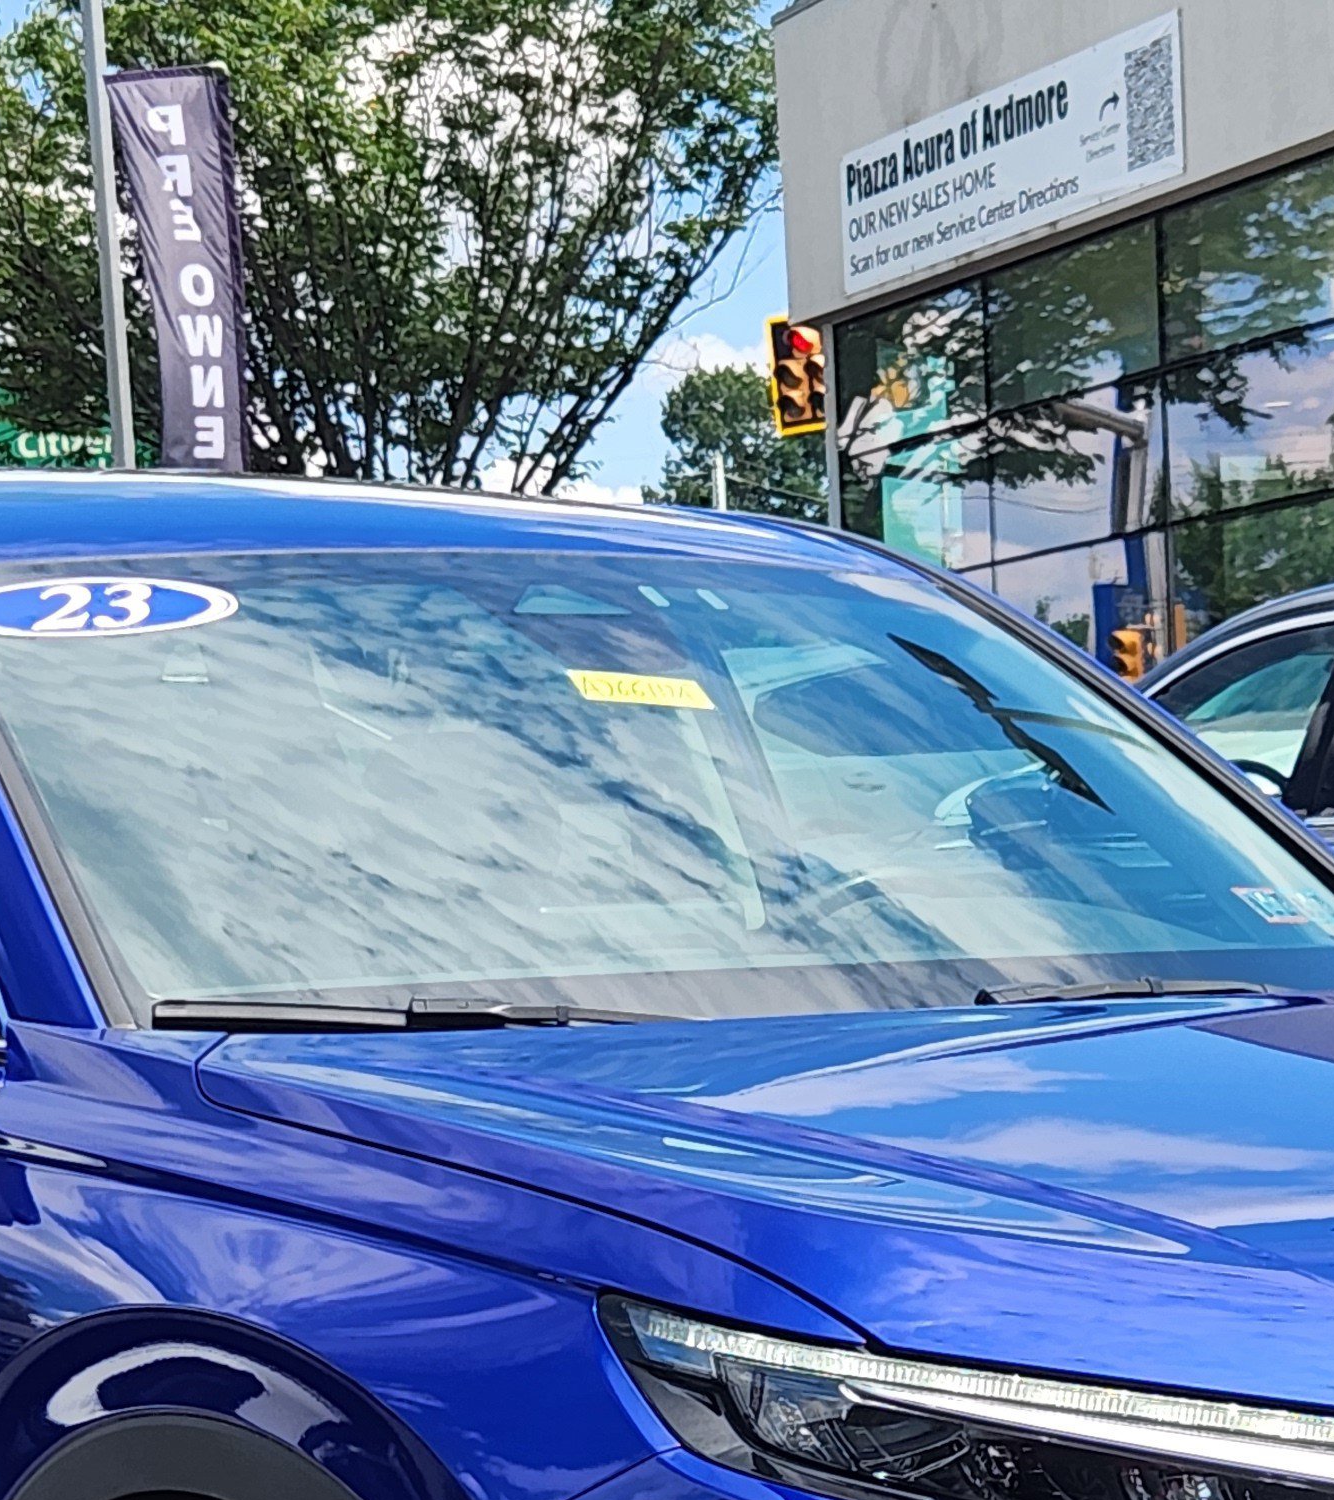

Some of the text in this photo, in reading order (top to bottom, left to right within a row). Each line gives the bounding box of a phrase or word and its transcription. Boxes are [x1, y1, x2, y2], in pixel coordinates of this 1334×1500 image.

[846, 80, 1068, 206] Piazza Acura of Ardmore
[849, 162, 996, 242] OUR NEW SALES HOME
[850, 176, 1079, 276] Scan for our new Service Center Directions
[30, 583, 152, 631] 23
